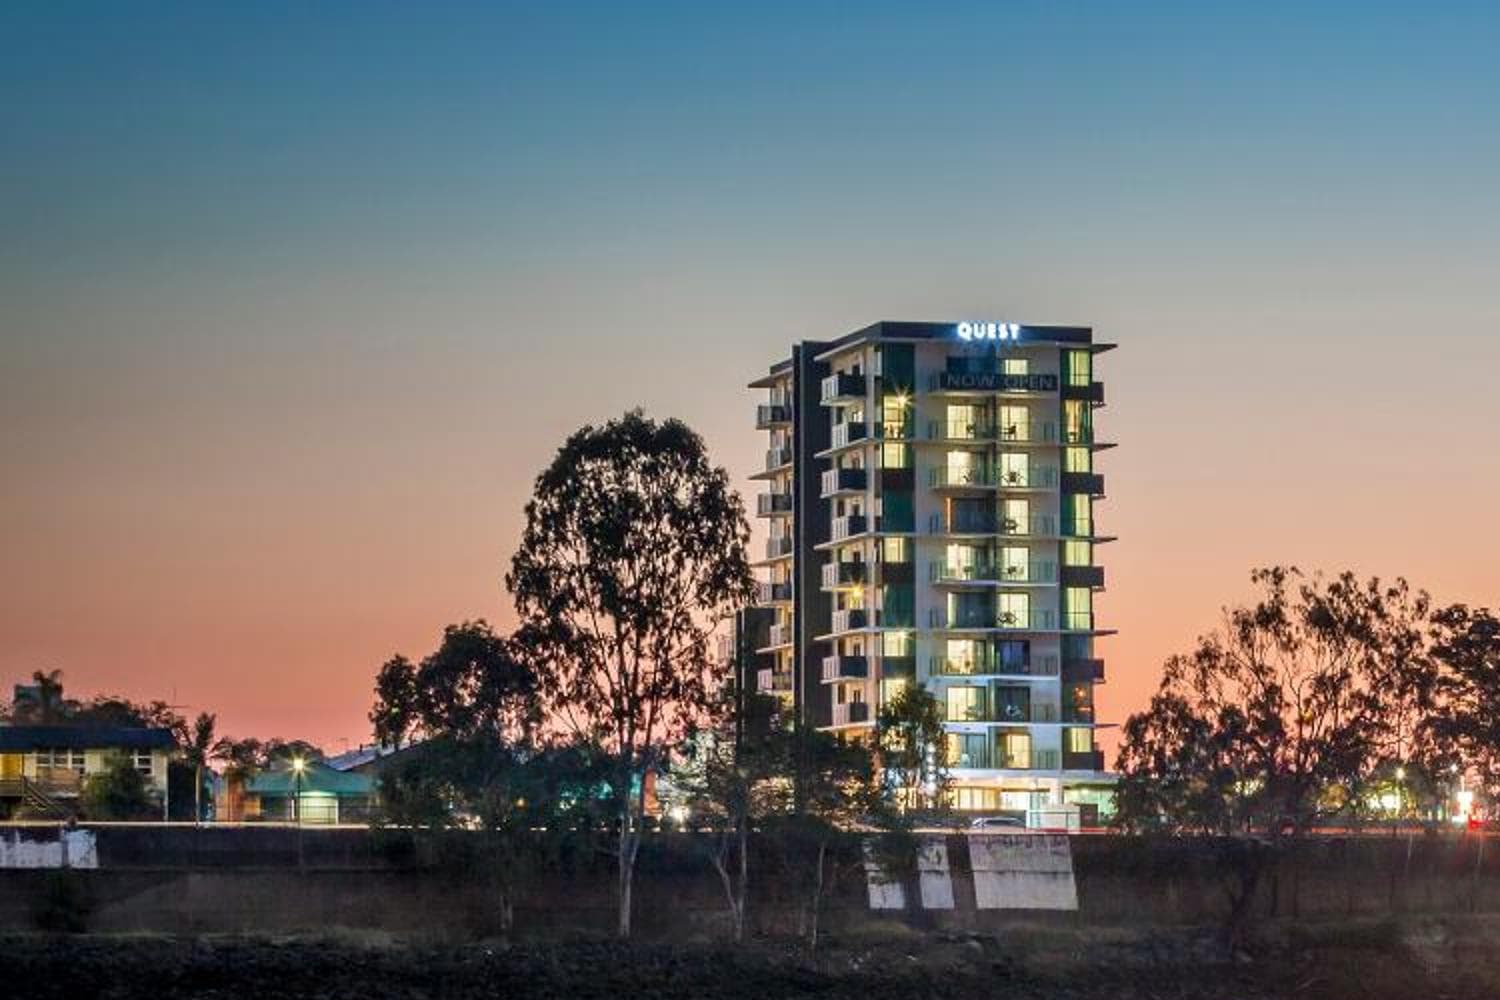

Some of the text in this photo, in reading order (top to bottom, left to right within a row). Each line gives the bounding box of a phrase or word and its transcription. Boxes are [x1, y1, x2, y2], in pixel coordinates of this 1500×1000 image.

[957, 322, 1020, 341] QUEST
[947, 374, 1053, 388] NOW OPEN
